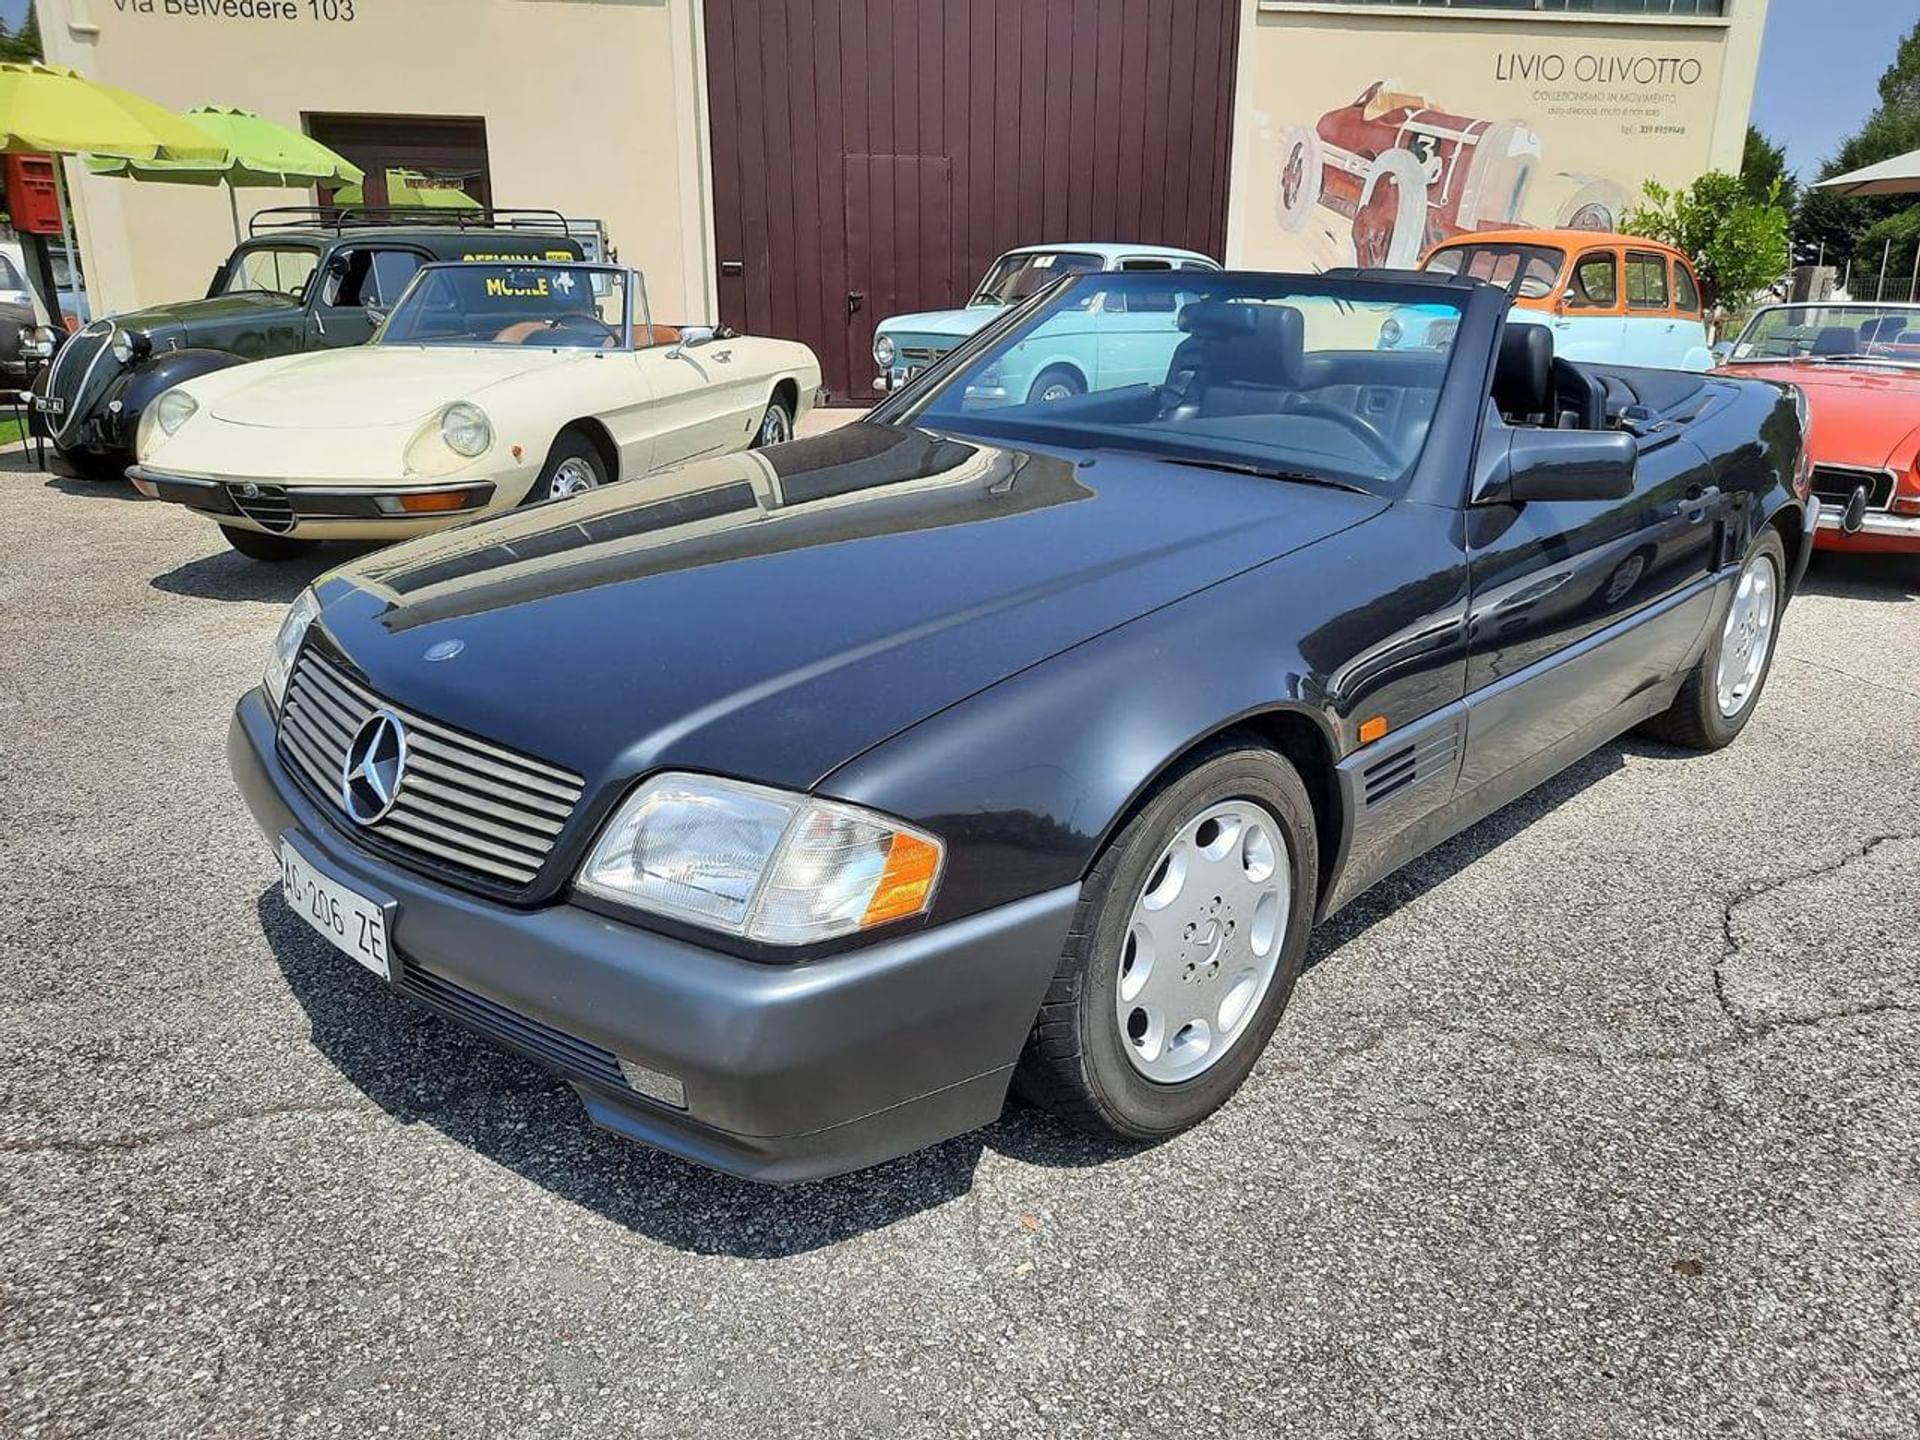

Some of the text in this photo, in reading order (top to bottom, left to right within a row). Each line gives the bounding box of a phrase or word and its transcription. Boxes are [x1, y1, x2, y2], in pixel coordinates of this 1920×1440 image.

[165, 0, 298, 20] Belvedere
[309, 0, 355, 22] 103
[1495, 53, 1702, 85] LIVIO OLIVOTTO
[1607, 91, 1618, 103] IN
[1619, 91, 1677, 105] MOVIMENTO
[285, 859, 384, 963] AG 206 ZE
